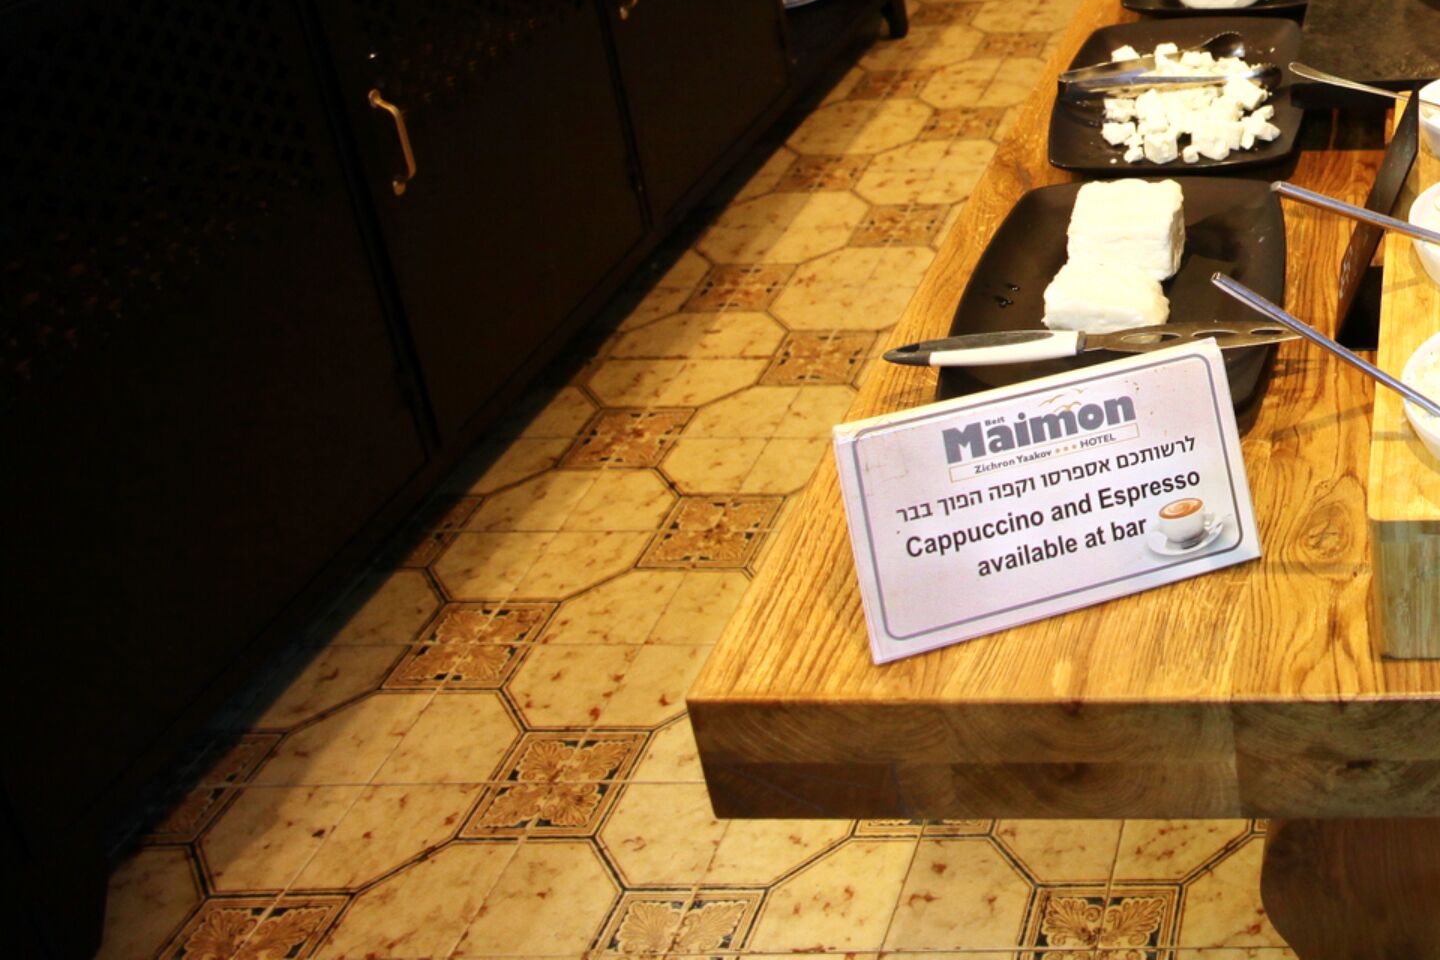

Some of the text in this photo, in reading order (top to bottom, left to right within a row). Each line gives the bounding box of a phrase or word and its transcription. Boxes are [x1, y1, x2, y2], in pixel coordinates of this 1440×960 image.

[941, 395, 1137, 465] Maimon
[974, 433, 1117, 475] Zichron Yaakov HOTEL
[984, 416, 1006, 428] Beit
[896, 435, 1195, 523] לרשותכם אספרסו וקפה הפוך בבר
[905, 470, 1201, 558] Cappuccino and Espresso
[977, 517, 1147, 577] available at bar
